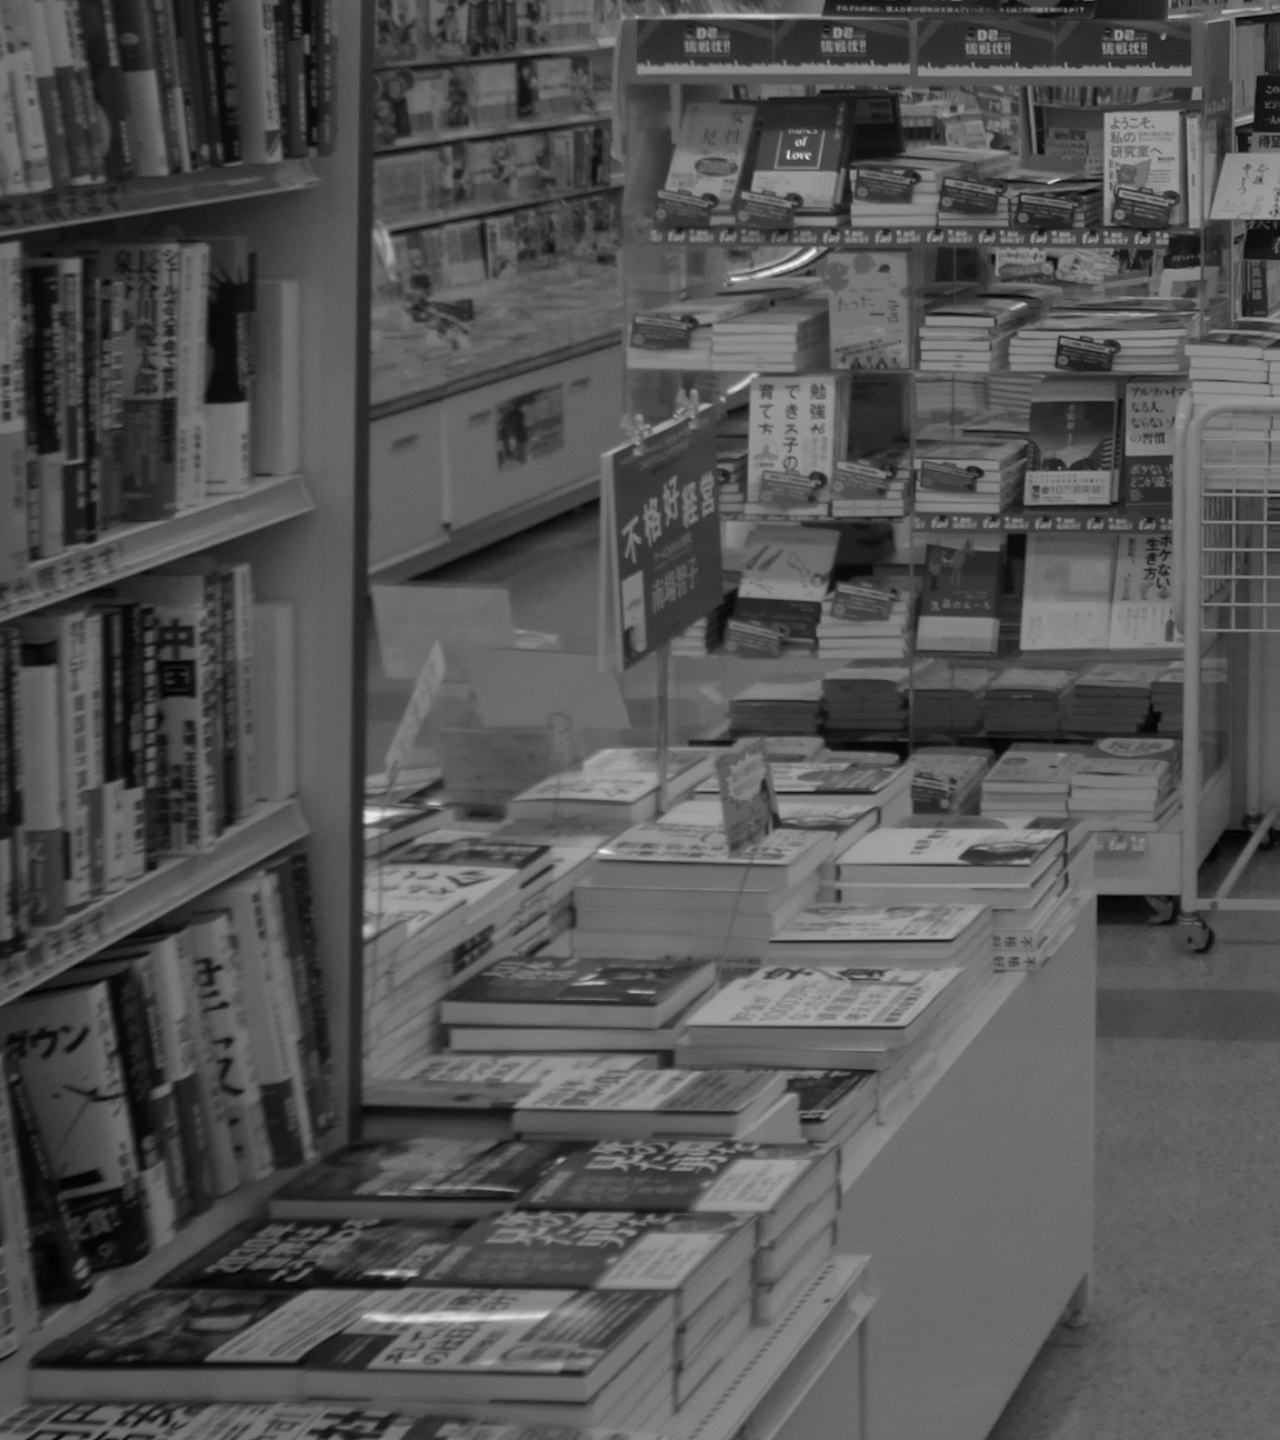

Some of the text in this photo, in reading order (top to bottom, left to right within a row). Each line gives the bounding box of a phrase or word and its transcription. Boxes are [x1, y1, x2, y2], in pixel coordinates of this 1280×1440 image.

[1109, 116, 1157, 132] ようこそ、
[793, 135, 810, 148] of
[1109, 132, 1137, 145] 私の
[785, 148, 813, 162] Love
[1109, 144, 1163, 158] 研究室へ
[758, 383, 776, 436] 育て方
[810, 383, 827, 435] 勉強が
[1131, 433, 1166, 446] の習慣
[621, 470, 716, 564] 不格好経営
